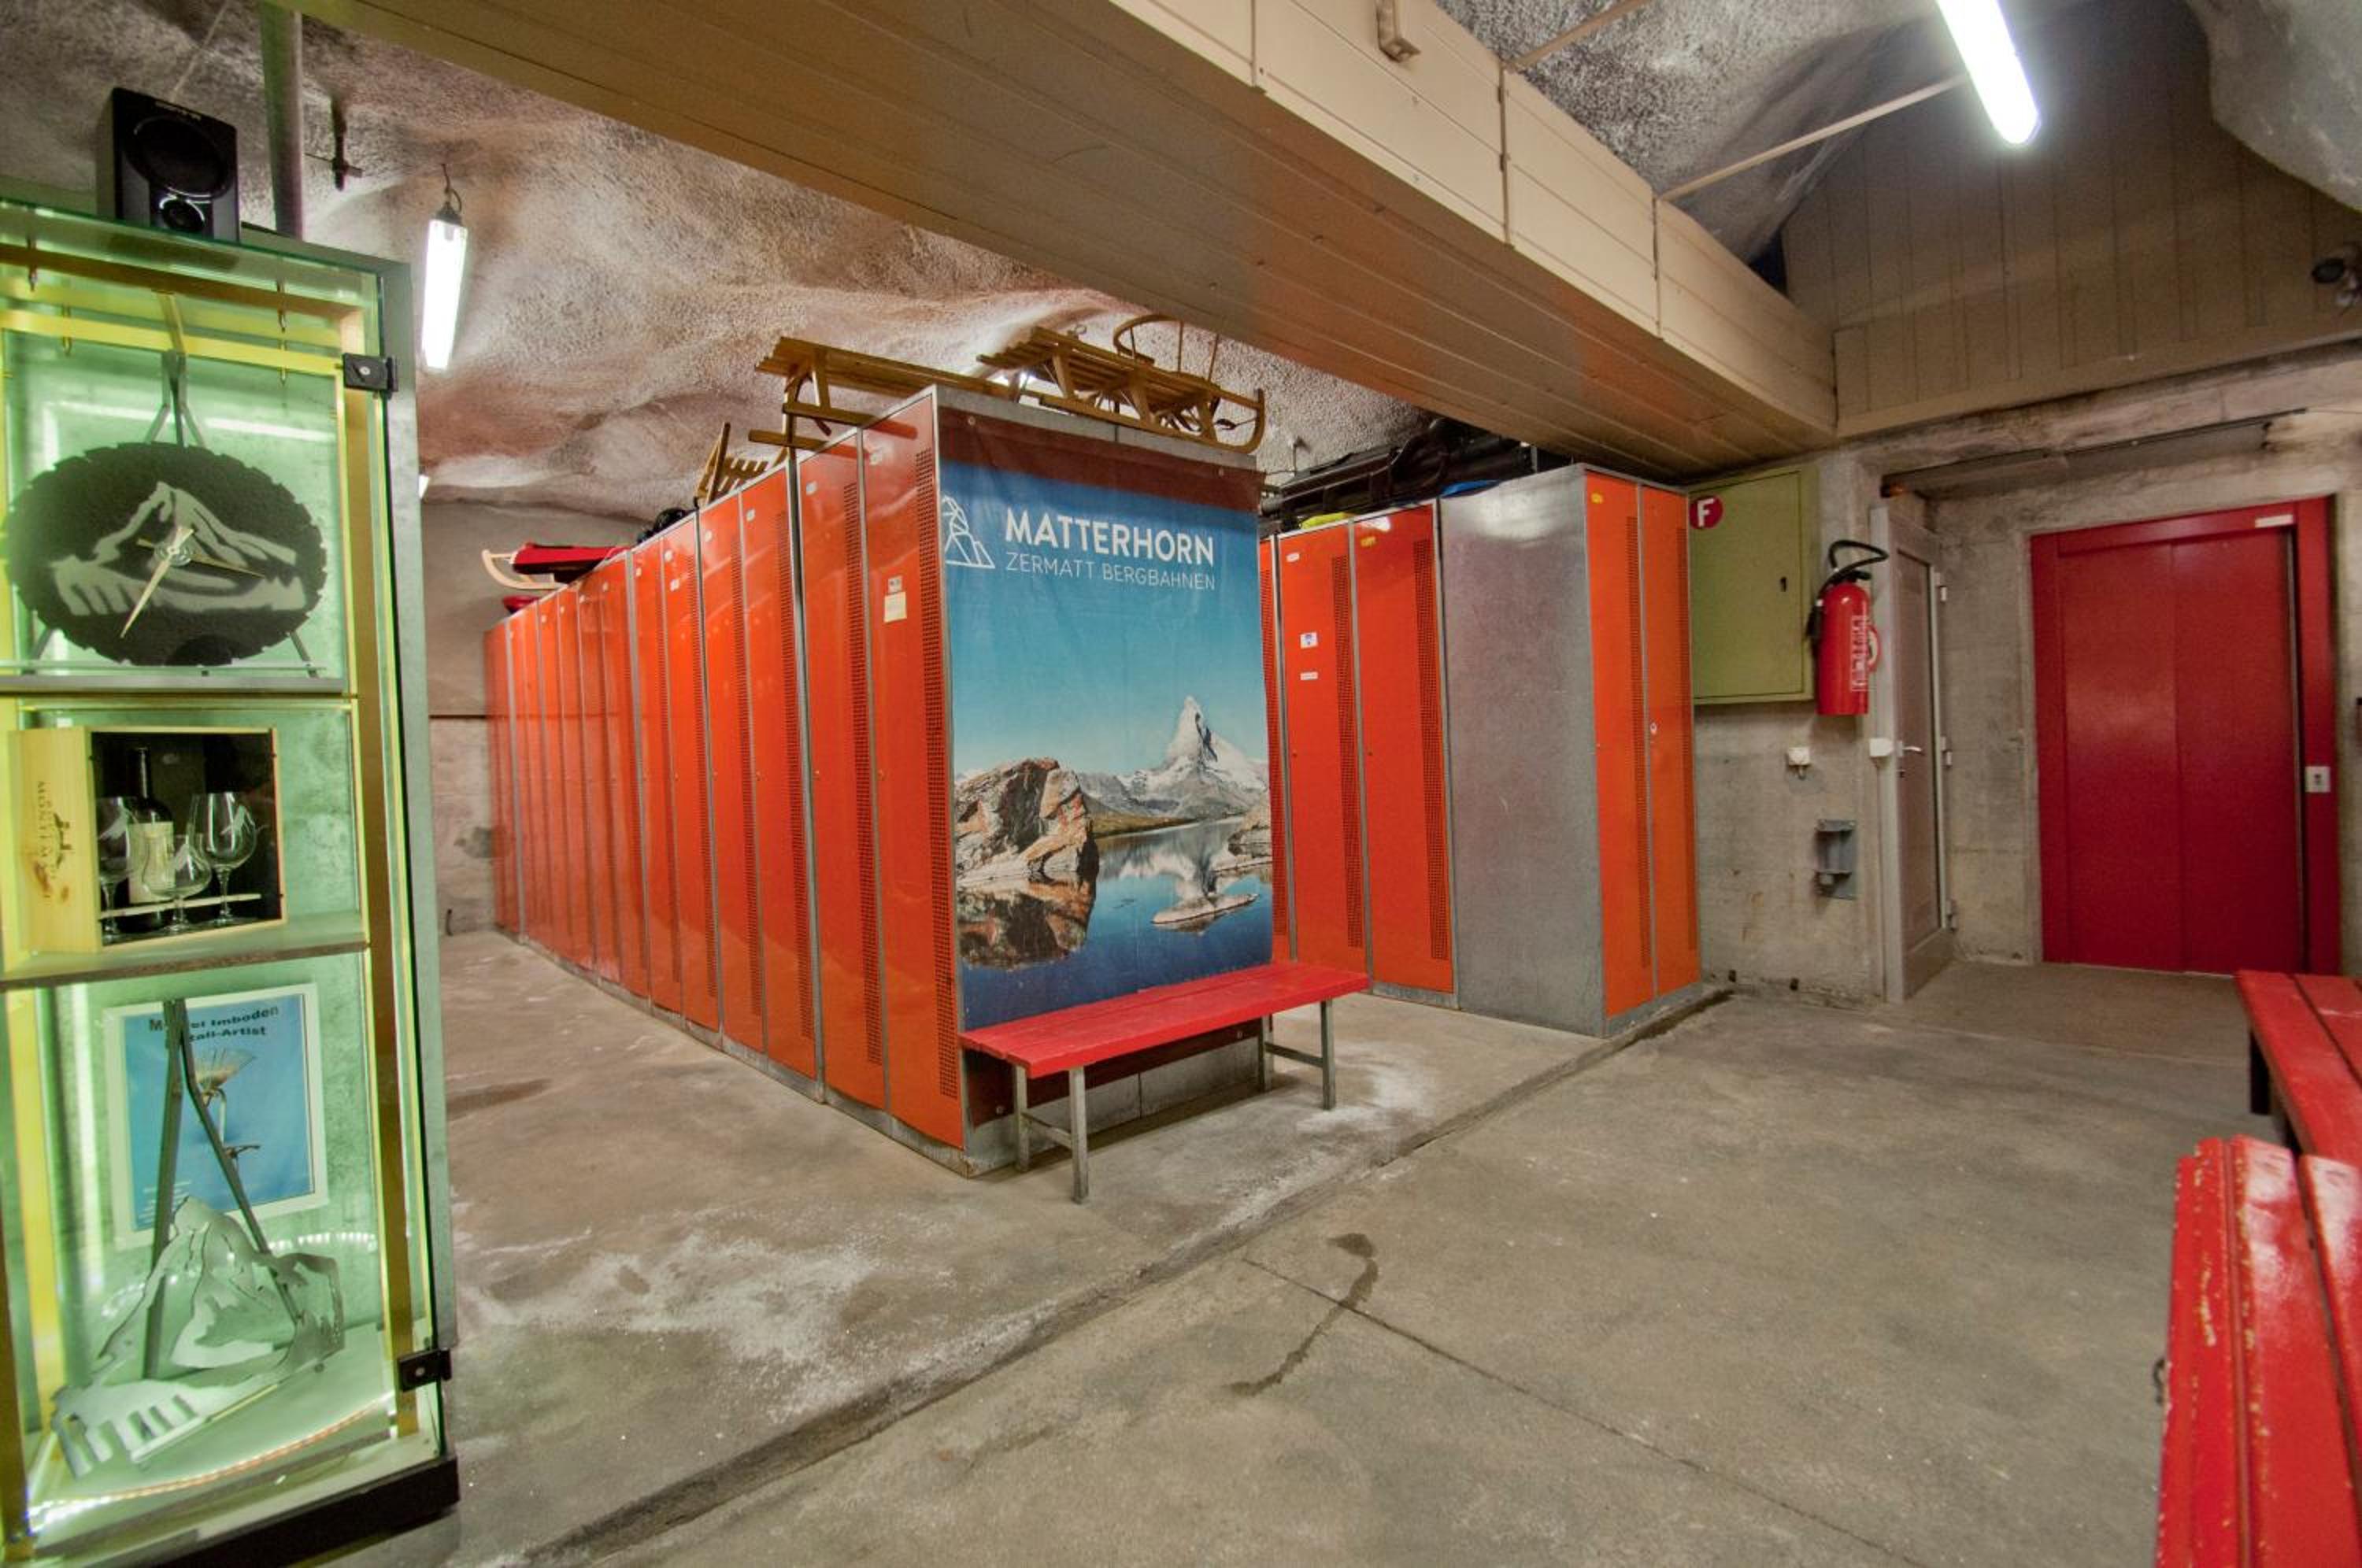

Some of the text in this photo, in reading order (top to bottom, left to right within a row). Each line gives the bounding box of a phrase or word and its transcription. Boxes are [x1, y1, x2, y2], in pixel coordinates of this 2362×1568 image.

[1697, 497, 1714, 527] F
[1005, 507, 1213, 567] MATTERHORN
[1006, 552, 1215, 590] ZERMATT BERGBAHNEN
[150, 1007, 279, 1031] Mel Imboden
